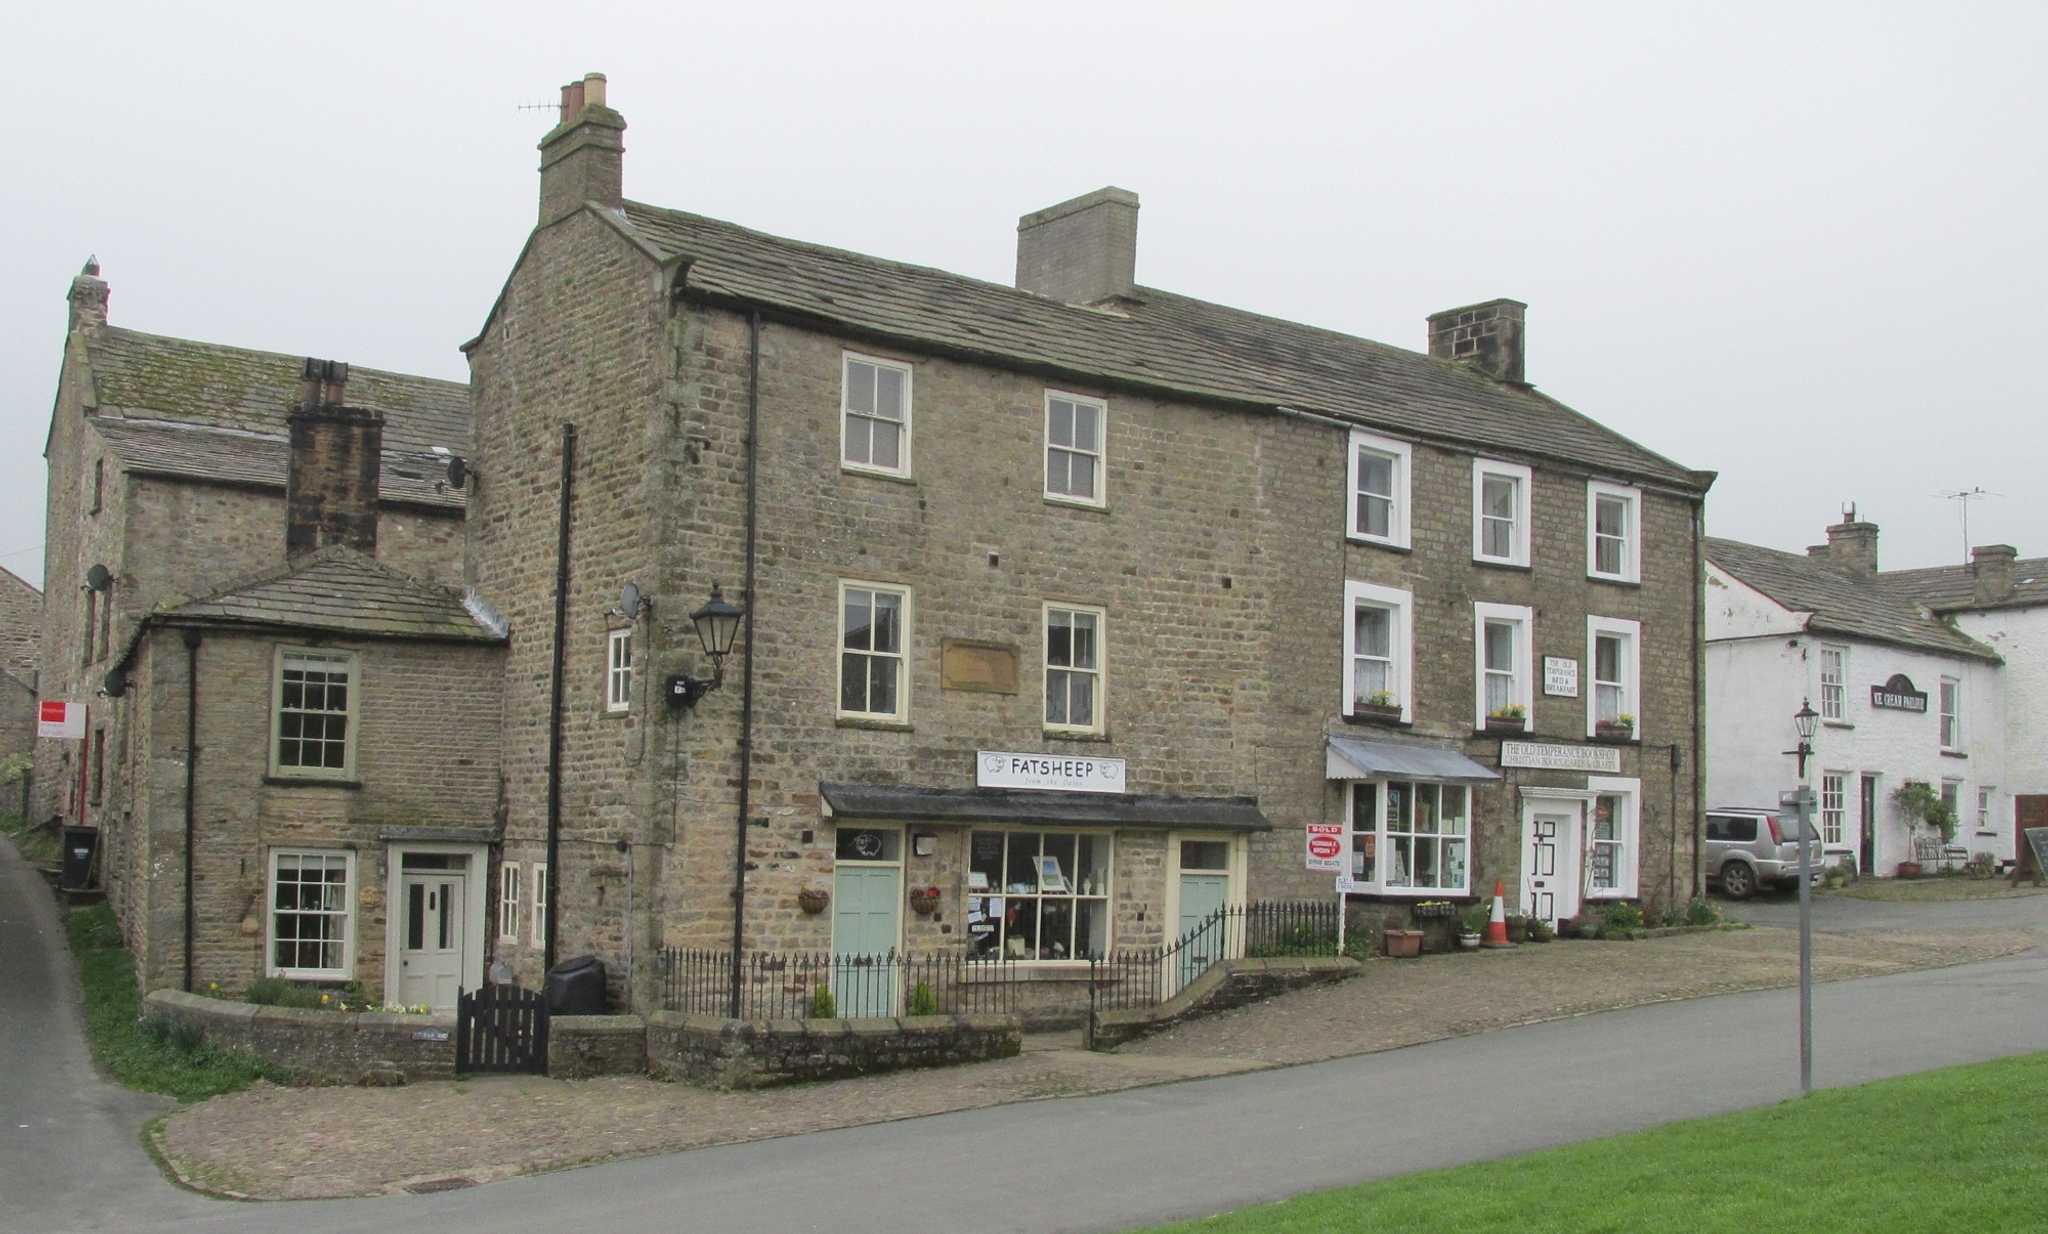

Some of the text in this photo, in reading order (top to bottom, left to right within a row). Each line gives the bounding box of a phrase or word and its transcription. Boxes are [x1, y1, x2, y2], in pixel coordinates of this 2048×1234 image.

[1884, 693, 1902, 707] CREAM
[1506, 743, 1519, 755] THE
[1521, 744, 1535, 756] OLD
[1536, 745, 1580, 758] TEMPERANCE
[1011, 758, 1093, 777] FATSHEEP
